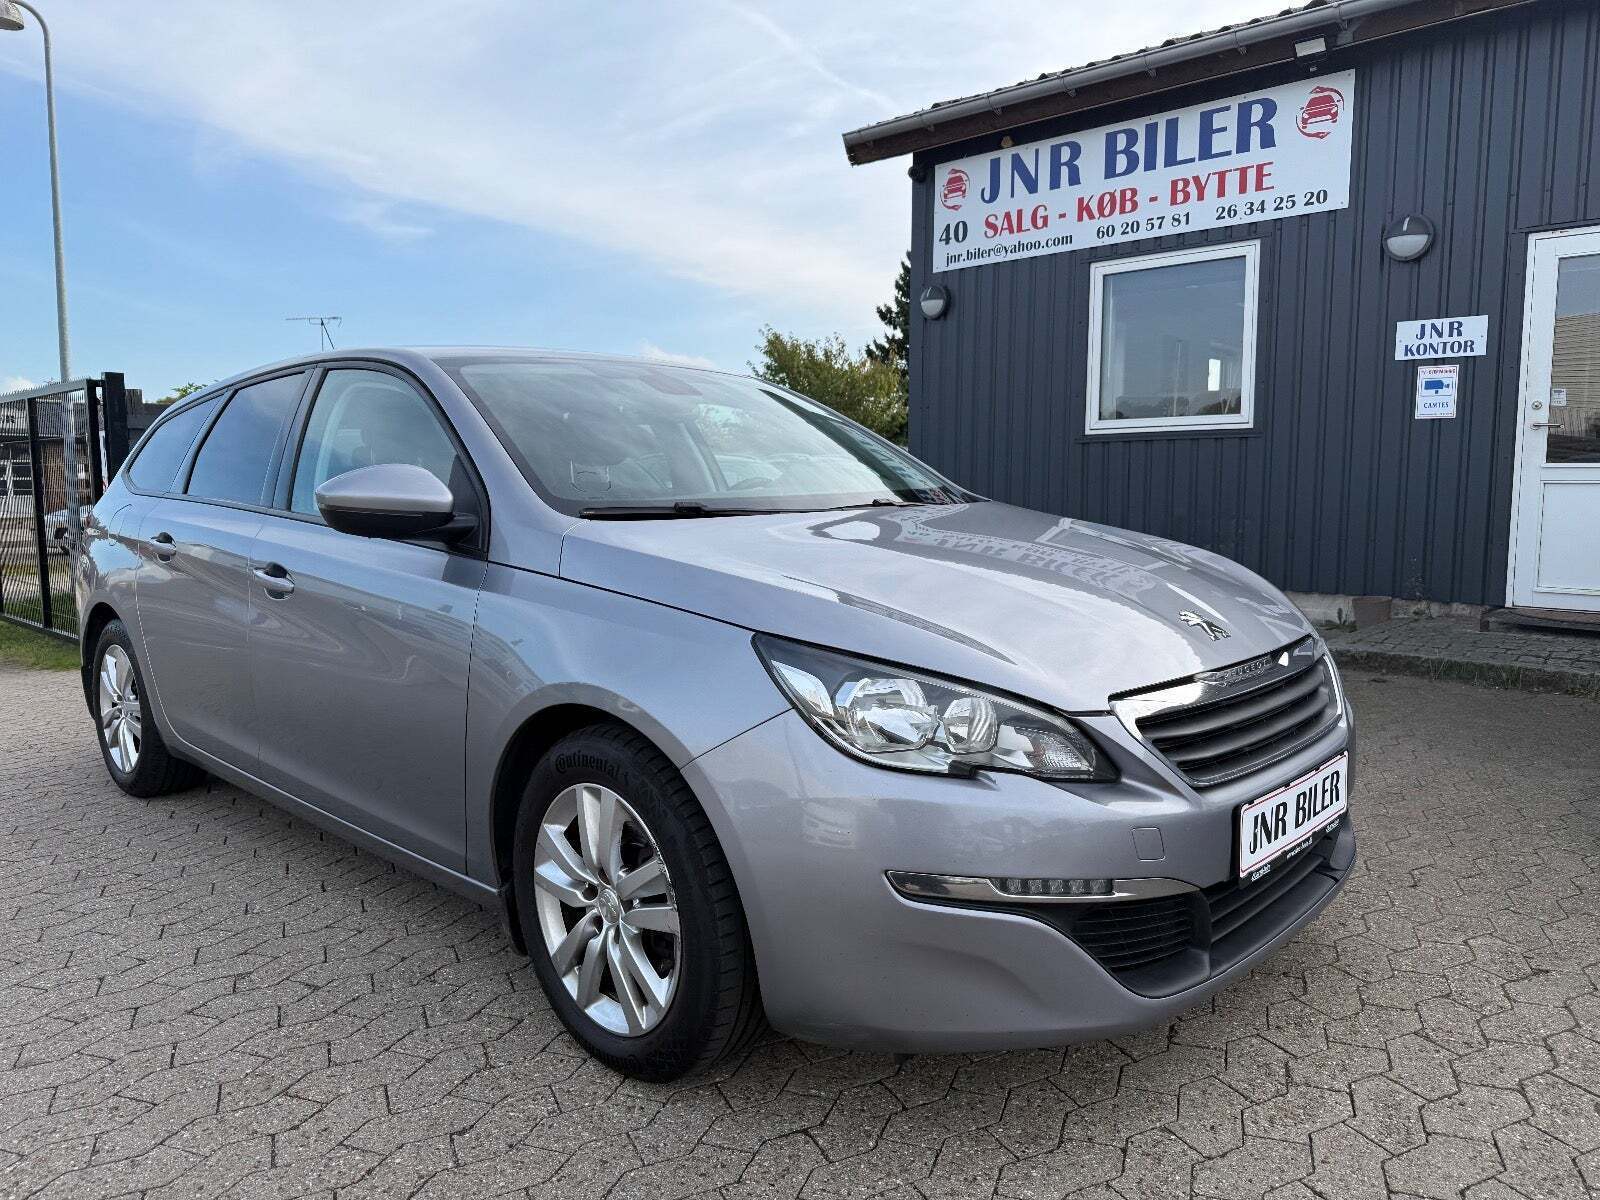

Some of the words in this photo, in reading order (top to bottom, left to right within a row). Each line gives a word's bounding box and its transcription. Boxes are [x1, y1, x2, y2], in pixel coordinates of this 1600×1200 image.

[980, 140, 1082, 204] JNR
[1103, 97, 1278, 180] BILER
[984, 204, 1049, 239] SALG
[1076, 187, 1139, 223] KØB
[1169, 161, 1275, 206] BYTTE
[1096, 224, 1116, 239] 60
[1120, 220, 1140, 235] 20
[1145, 215, 1166, 231] 57
[1171, 211, 1190, 227] 81
[1215, 204, 1238, 220] 26
[1243, 199, 1266, 216] 34
[1273, 194, 1296, 211] 25
[1303, 189, 1328, 206] 20
[939, 220, 969, 245] 40
[945, 234, 1073, 267] jnr.biler@yahoo.com
[1415, 320, 1463, 340] JNR
[1403, 339, 1475, 357] KONTOR
[554, 749, 620, 777] Continental
[1249, 801, 1288, 855] JNR
[1294, 769, 1340, 829] BILER
